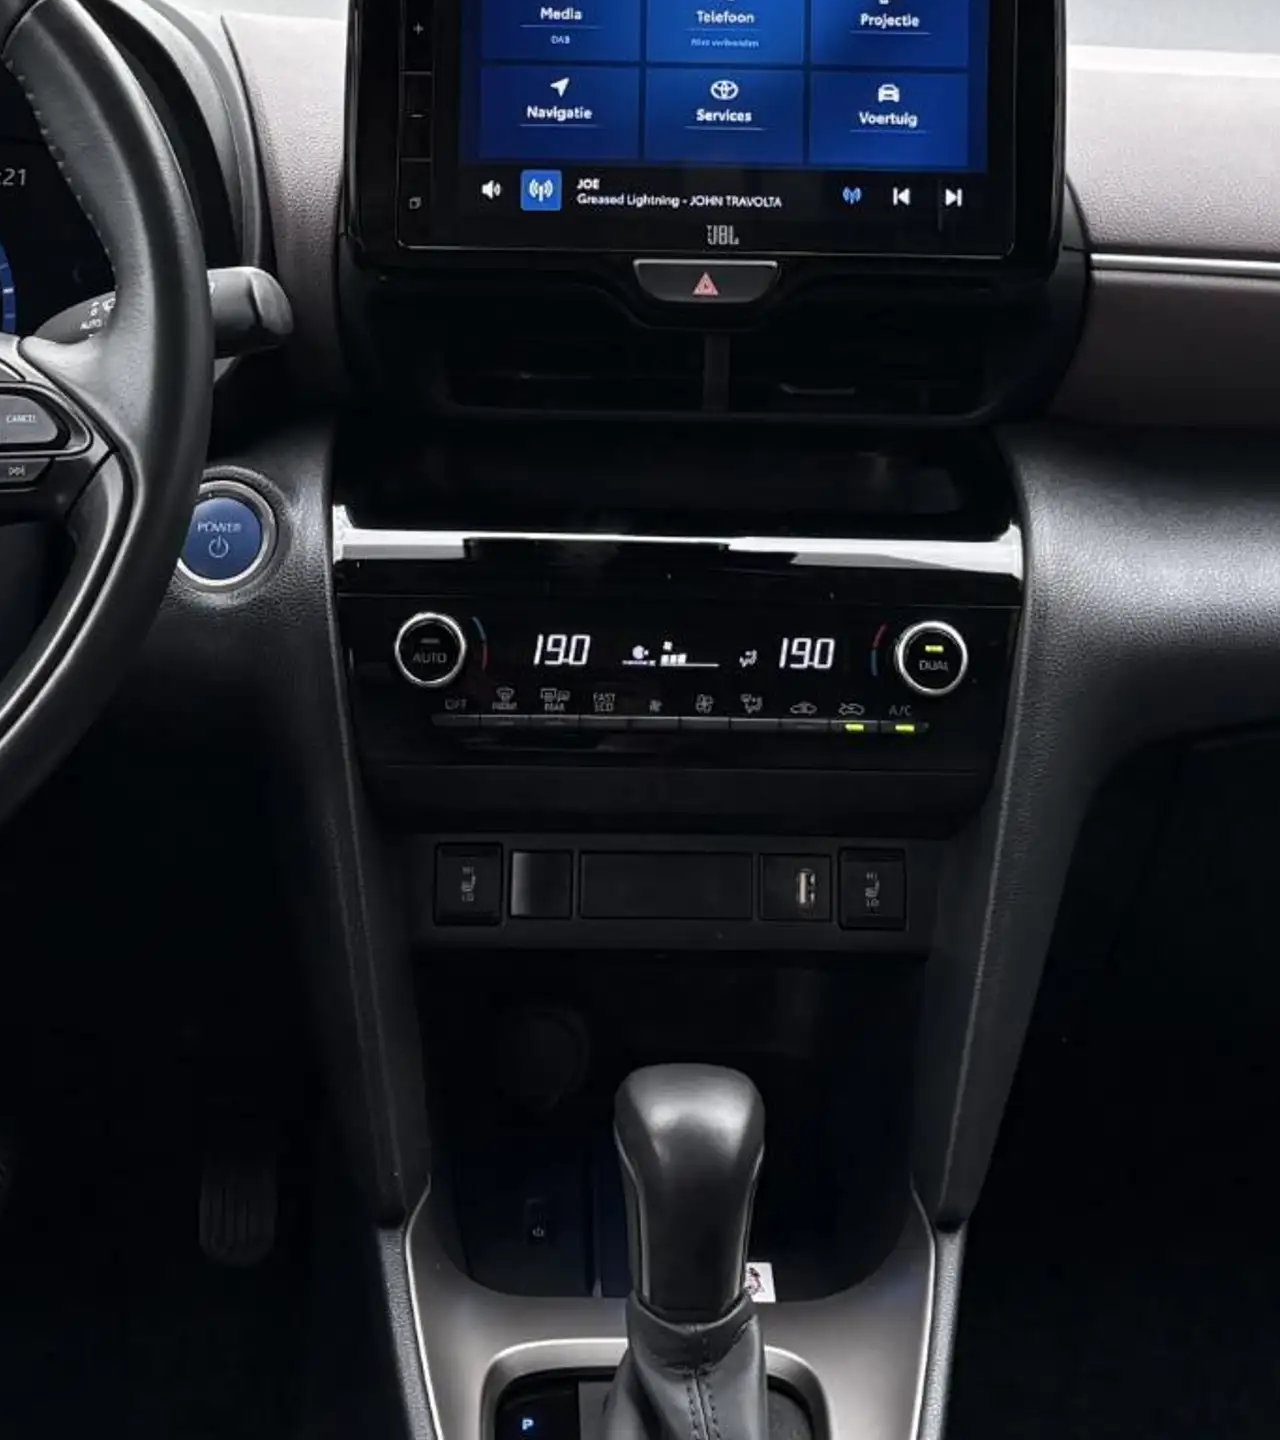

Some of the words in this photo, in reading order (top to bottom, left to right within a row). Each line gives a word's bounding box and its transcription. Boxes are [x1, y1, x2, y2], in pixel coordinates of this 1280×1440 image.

[540, 7, 582, 21] Media
[696, 10, 755, 24] Telefoon
[860, 13, 920, 29] Projectie
[527, 106, 592, 123] Navigatie
[696, 109, 752, 122] Services
[859, 112, 918, 128] Voertuig
[577, 178, 600, 190] JOE
[577, 193, 624, 206] Greased
[627, 194, 680, 208] Lightning
[690, 195, 723, 208] JOHN
[725, 196, 783, 209] TRAVOLTA
[706, 224, 739, 245] JBL
[6, 414, 37, 423] CANCEL
[197, 521, 241, 533] POWER
[412, 652, 447, 664] AUTO
[919, 660, 949, 672] DUAL
[592, 692, 616, 702] FAST
[444, 698, 468, 710] OFF
[888, 704, 912, 716] A/C
[522, 1419, 534, 1431] P
